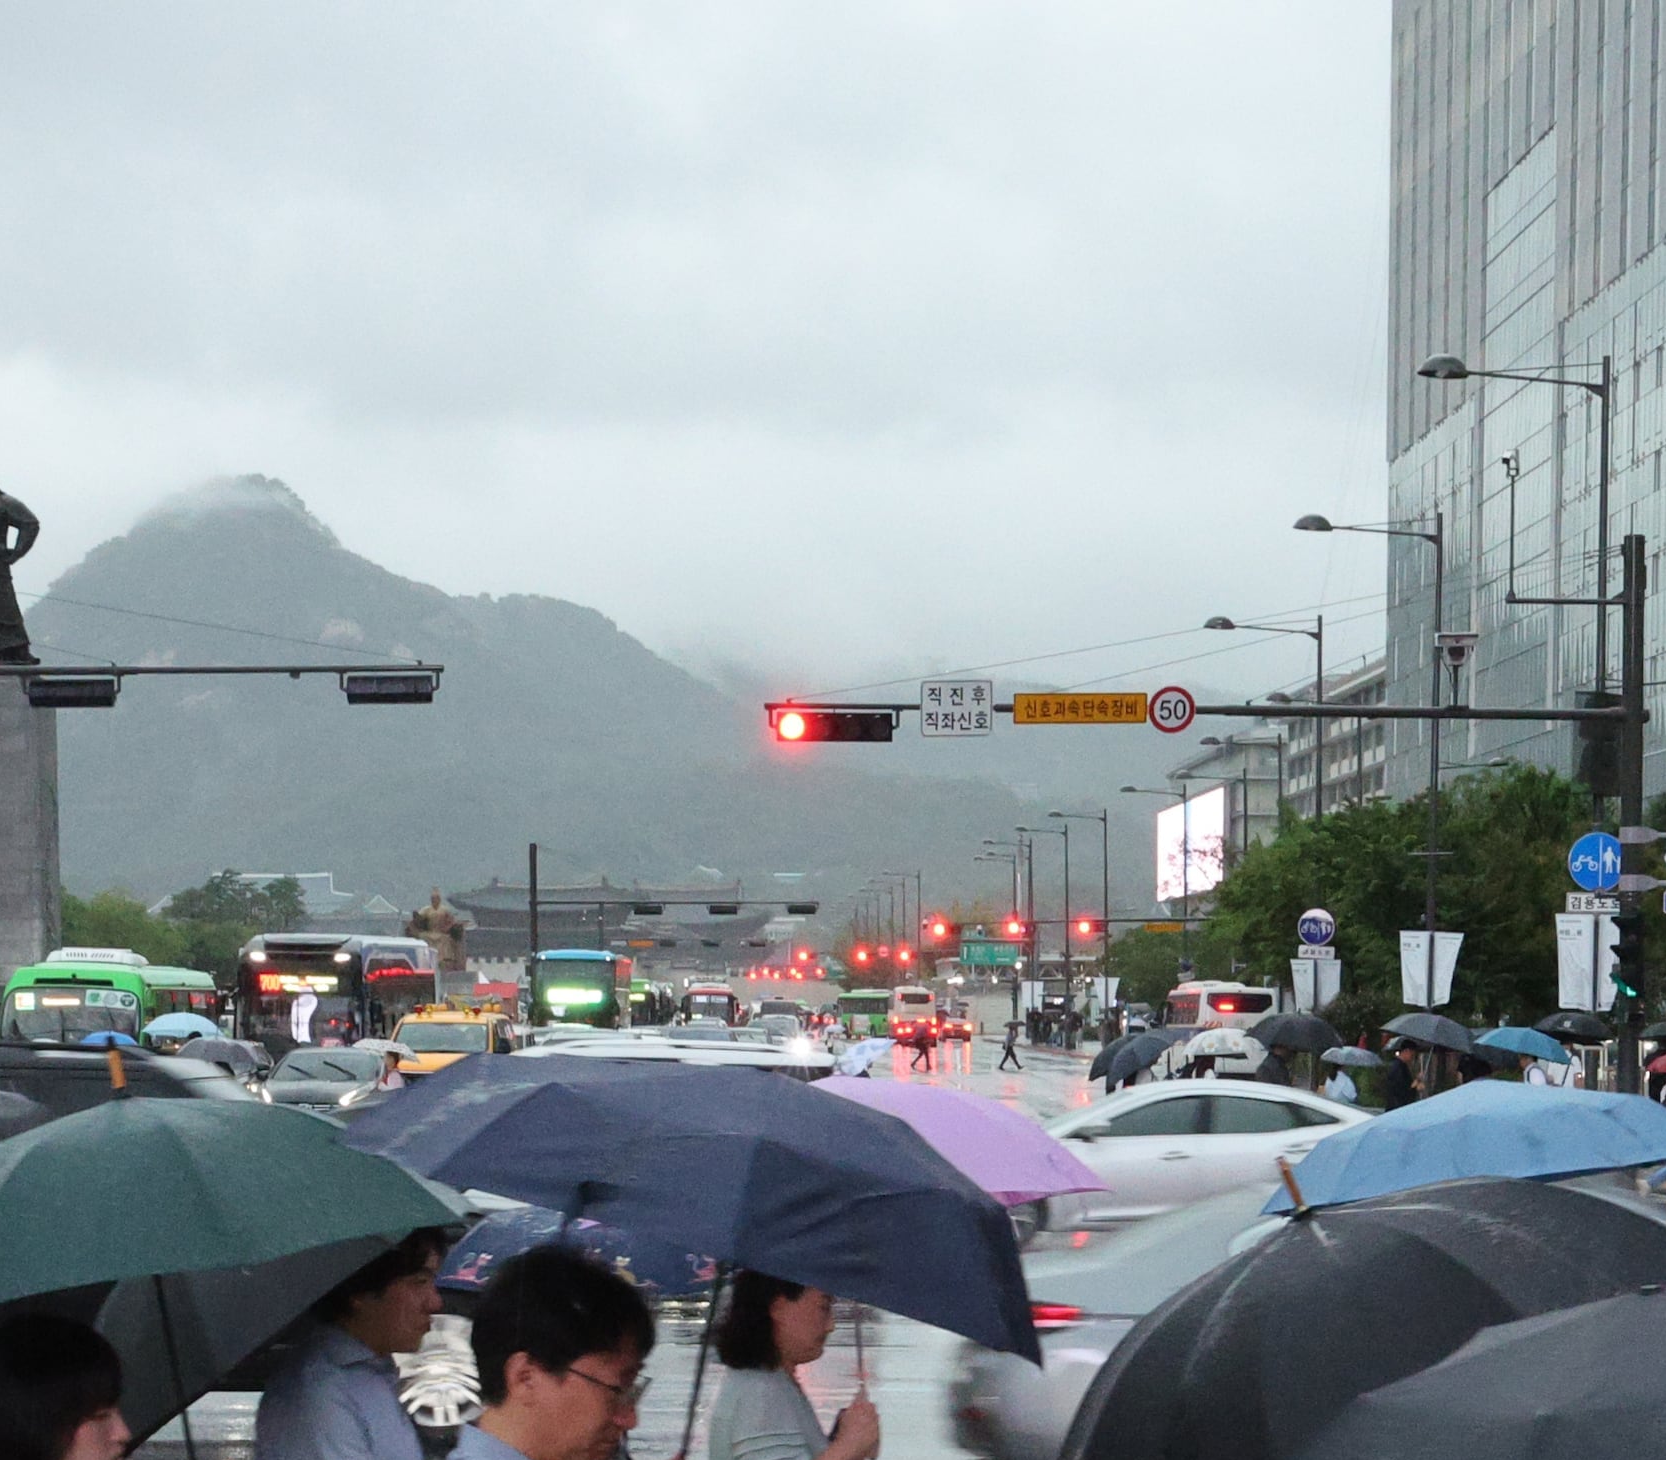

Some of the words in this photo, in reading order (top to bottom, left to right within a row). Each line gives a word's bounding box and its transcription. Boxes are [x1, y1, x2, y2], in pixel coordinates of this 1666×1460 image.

[1024, 701, 1138, 719] 신호과속단속장비
[1159, 699, 1187, 721] 50
[924, 711, 988, 731] 직좌신호
[259, 974, 281, 991] 700
